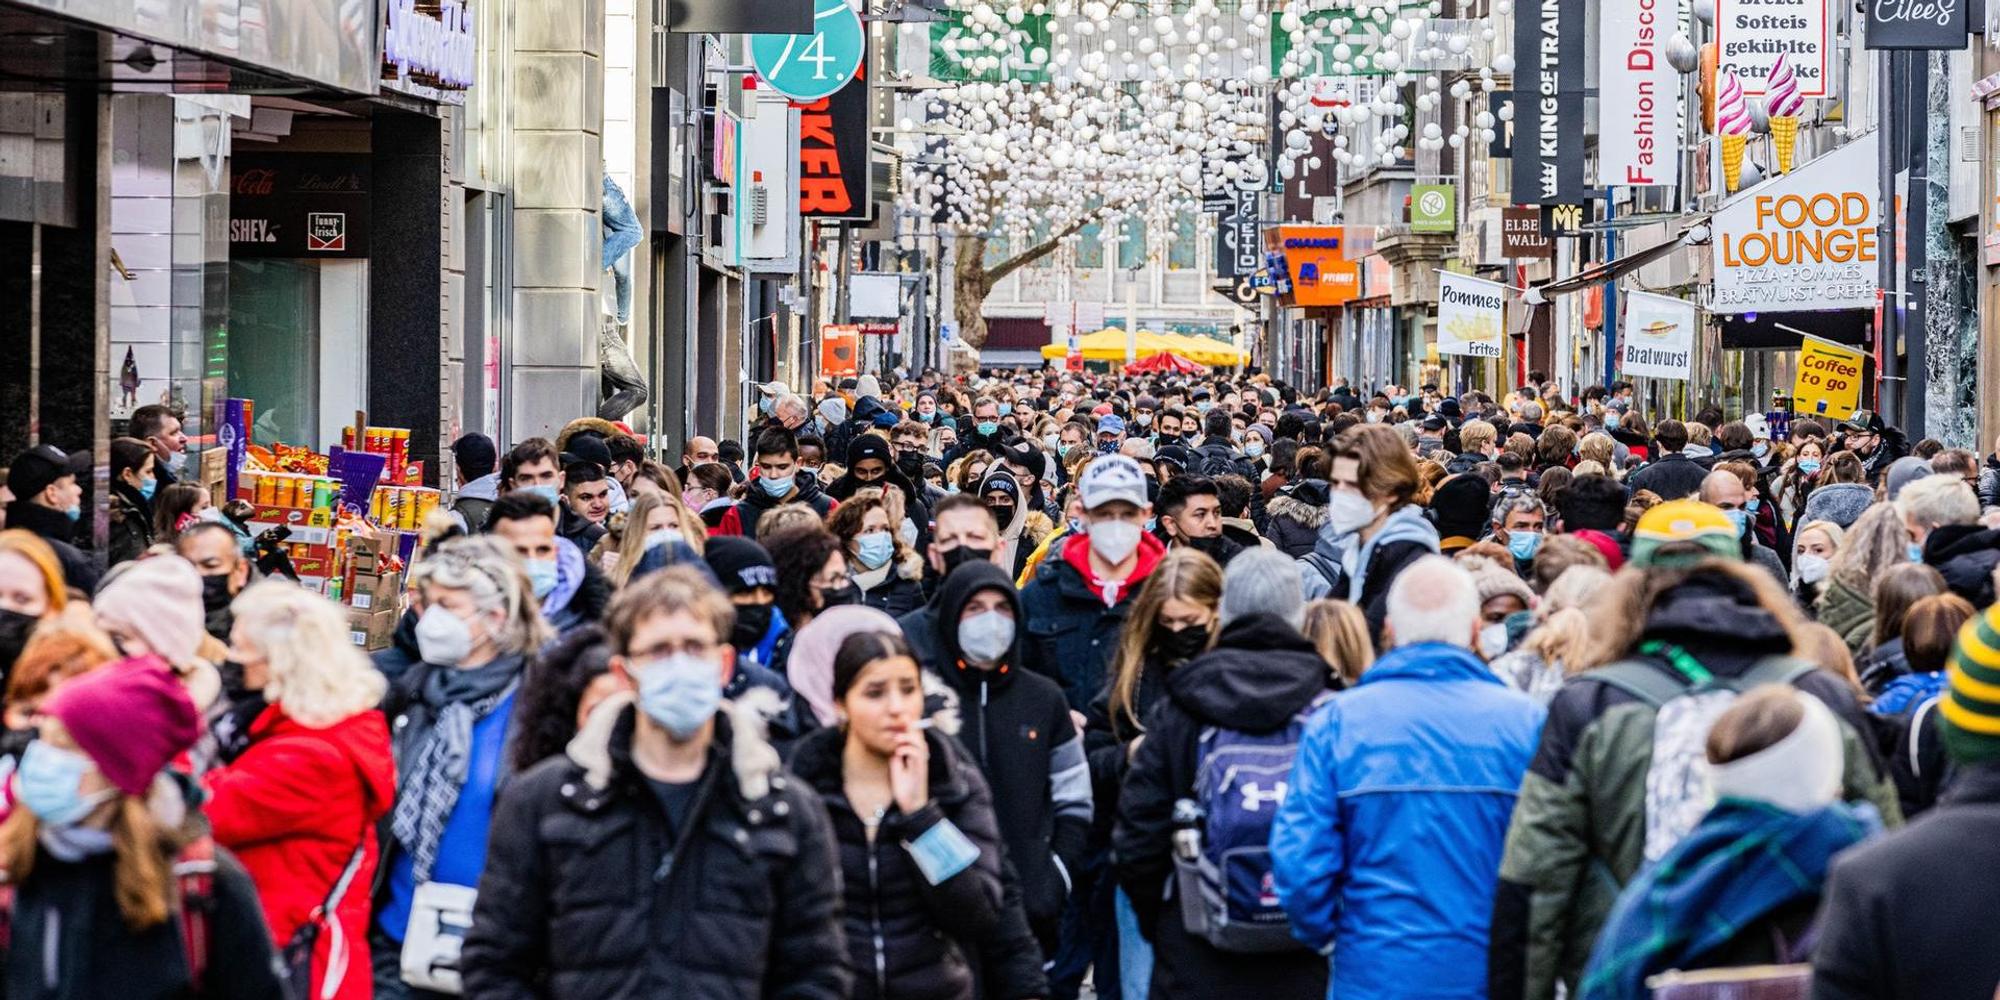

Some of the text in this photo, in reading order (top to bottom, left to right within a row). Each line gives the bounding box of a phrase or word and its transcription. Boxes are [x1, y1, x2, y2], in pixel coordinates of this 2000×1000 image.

[1735, 15, 1808, 29] Softeis
[1725, 39, 1817, 57] gekühlte
[1722, 63, 1819, 78] Getrke
[1540, 70, 1558, 97] OF
[1540, 98, 1558, 157] KING
[1627, 82, 1654, 183] Fashion
[1755, 192, 1870, 230] FOOD
[315, 226, 338, 237] frisch
[1504, 219, 1538, 232] ELBE
[1507, 234, 1548, 247] WALD
[1723, 227, 1877, 267] LOUNGE
[1441, 285, 1501, 310] Pommes
[1719, 285, 1816, 305] BRATWURST
[1469, 341, 1500, 356] Frites
[1626, 345, 1689, 368] Bratwurst
[1802, 354, 1858, 378] Coffee
[1801, 371, 1848, 392] to go
